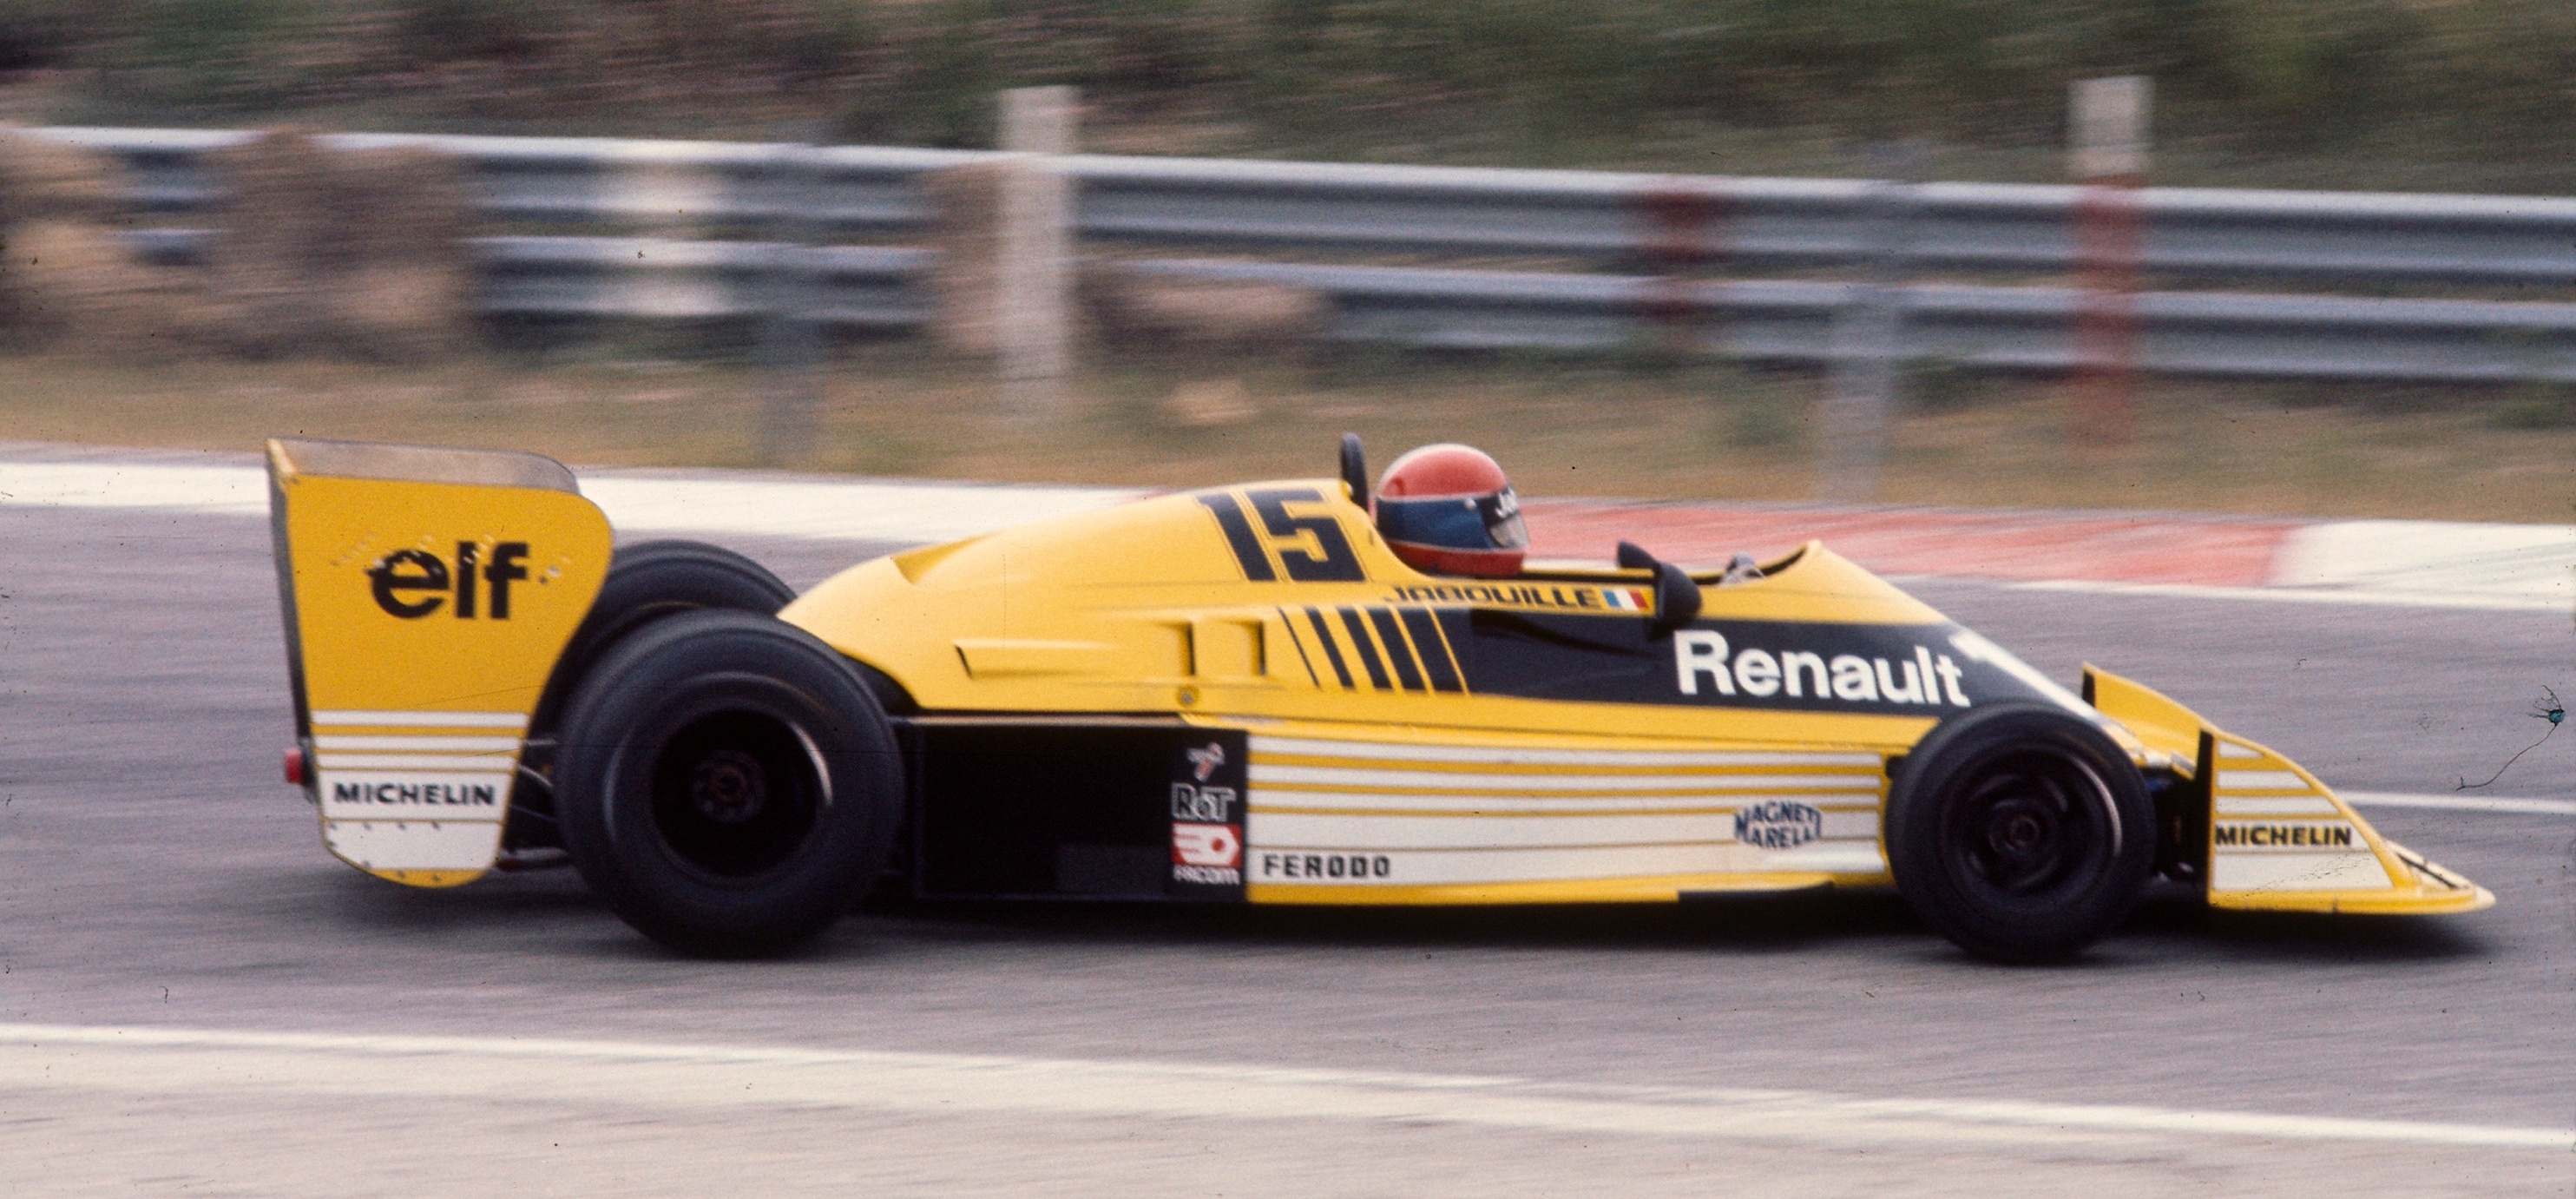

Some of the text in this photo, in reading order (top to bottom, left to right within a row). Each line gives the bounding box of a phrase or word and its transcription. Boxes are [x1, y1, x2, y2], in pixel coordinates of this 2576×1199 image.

[1196, 487, 1367, 583] 15
[365, 541, 529, 620] elf
[1383, 583, 1603, 609] JABOUILLE
[1673, 629, 1970, 708] Renault
[332, 781, 496, 807] MICHELIN
[2215, 824, 2352, 846] MICHELIN
[1263, 853, 1390, 878] FERODO
